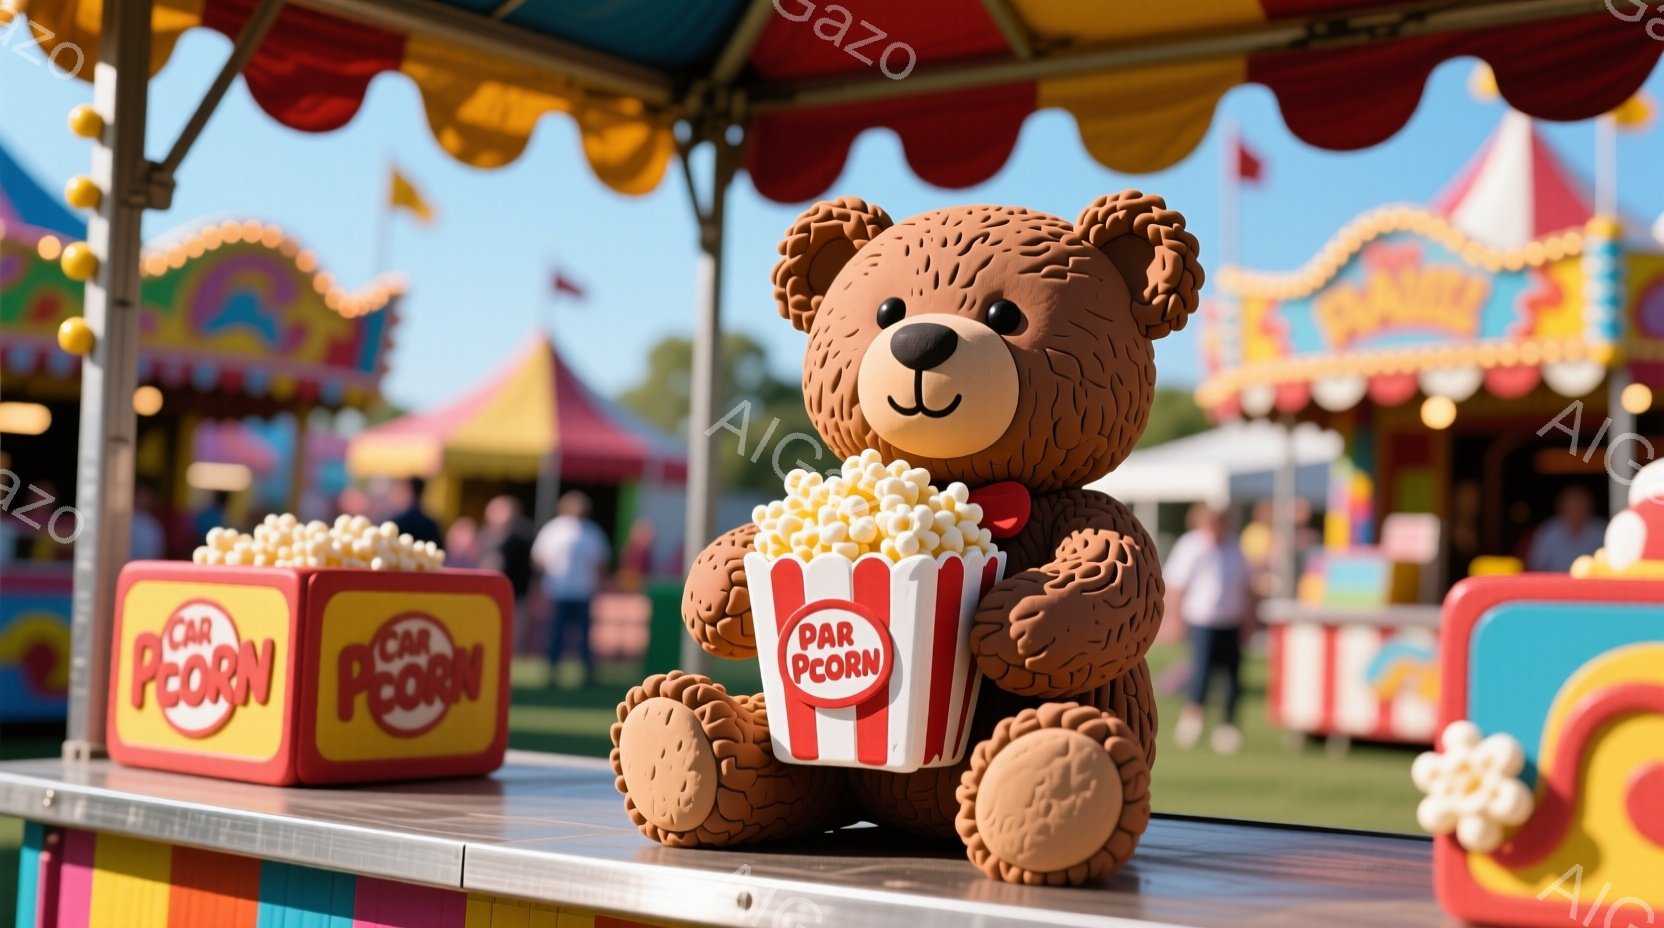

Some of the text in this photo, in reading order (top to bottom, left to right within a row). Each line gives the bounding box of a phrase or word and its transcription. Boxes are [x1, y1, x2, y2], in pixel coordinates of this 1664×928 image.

[168, 616, 212, 651] CAR
[379, 628, 431, 661] CAR
[798, 621, 855, 651] PAR
